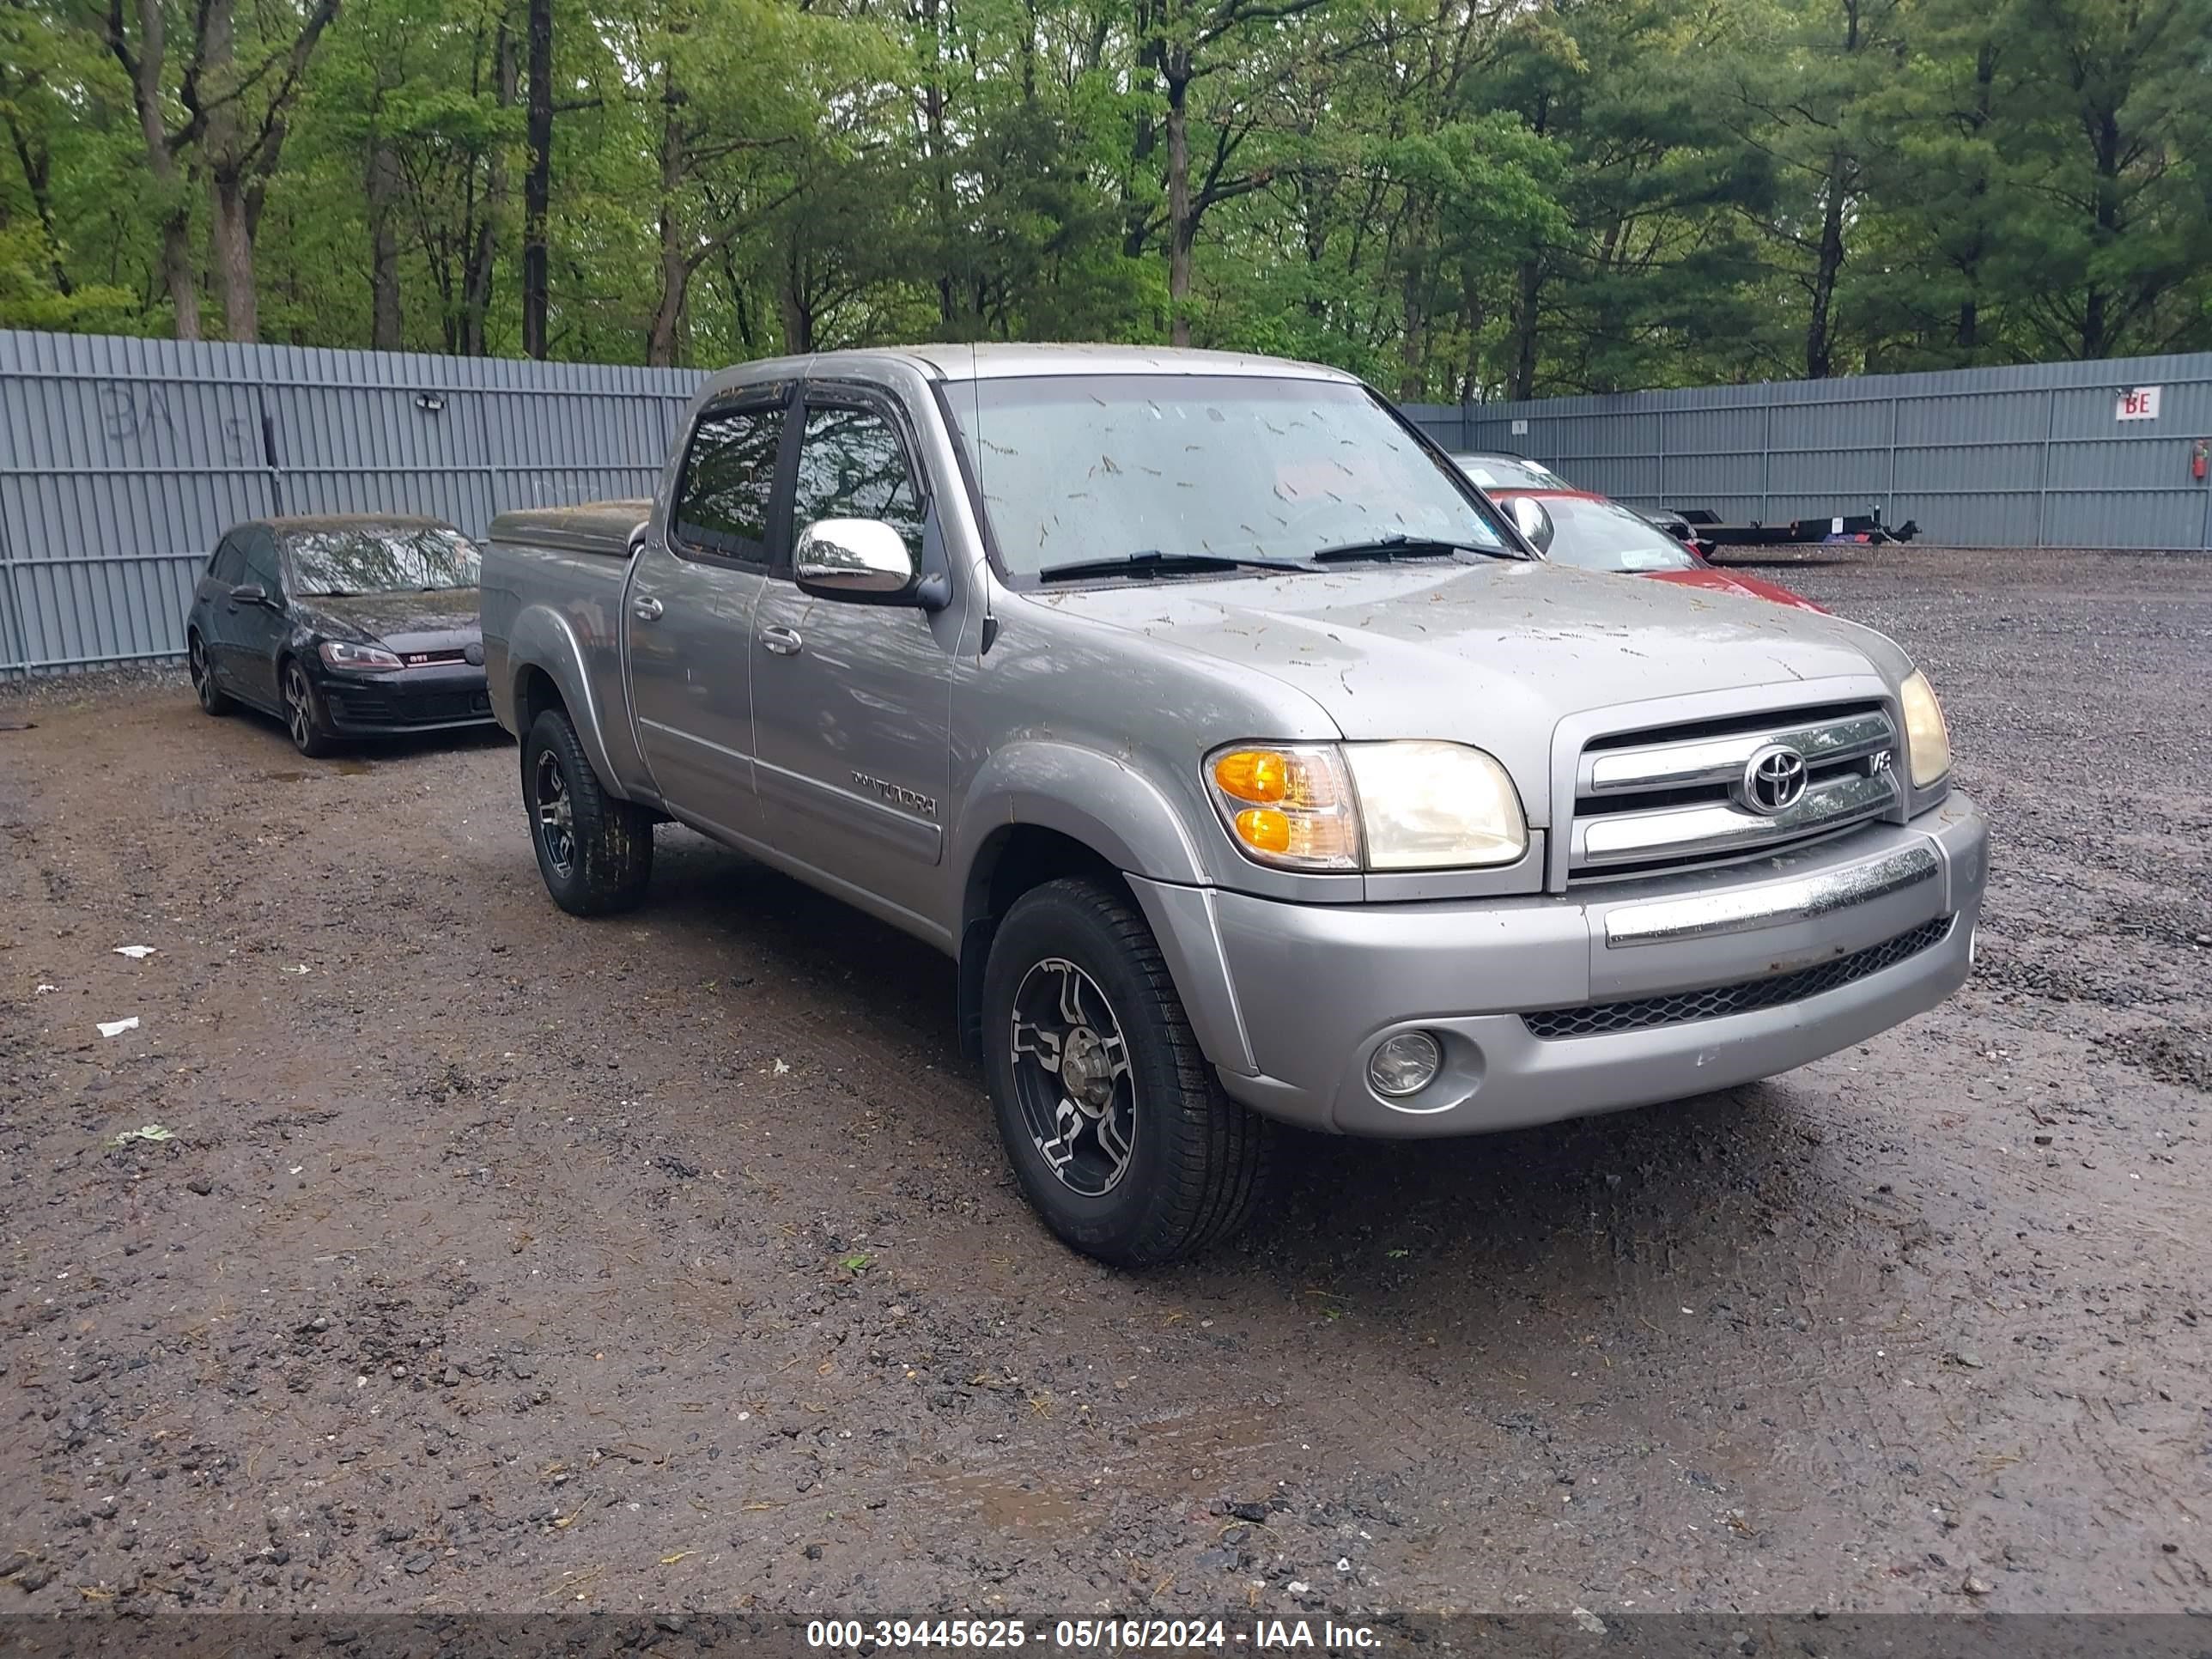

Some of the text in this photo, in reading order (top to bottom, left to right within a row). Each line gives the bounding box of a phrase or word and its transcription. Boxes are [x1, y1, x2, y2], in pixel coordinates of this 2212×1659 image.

[2125, 393, 2150, 414] BE
[1869, 750, 1893, 776] V8
[876, 778, 939, 817] TUNDRA
